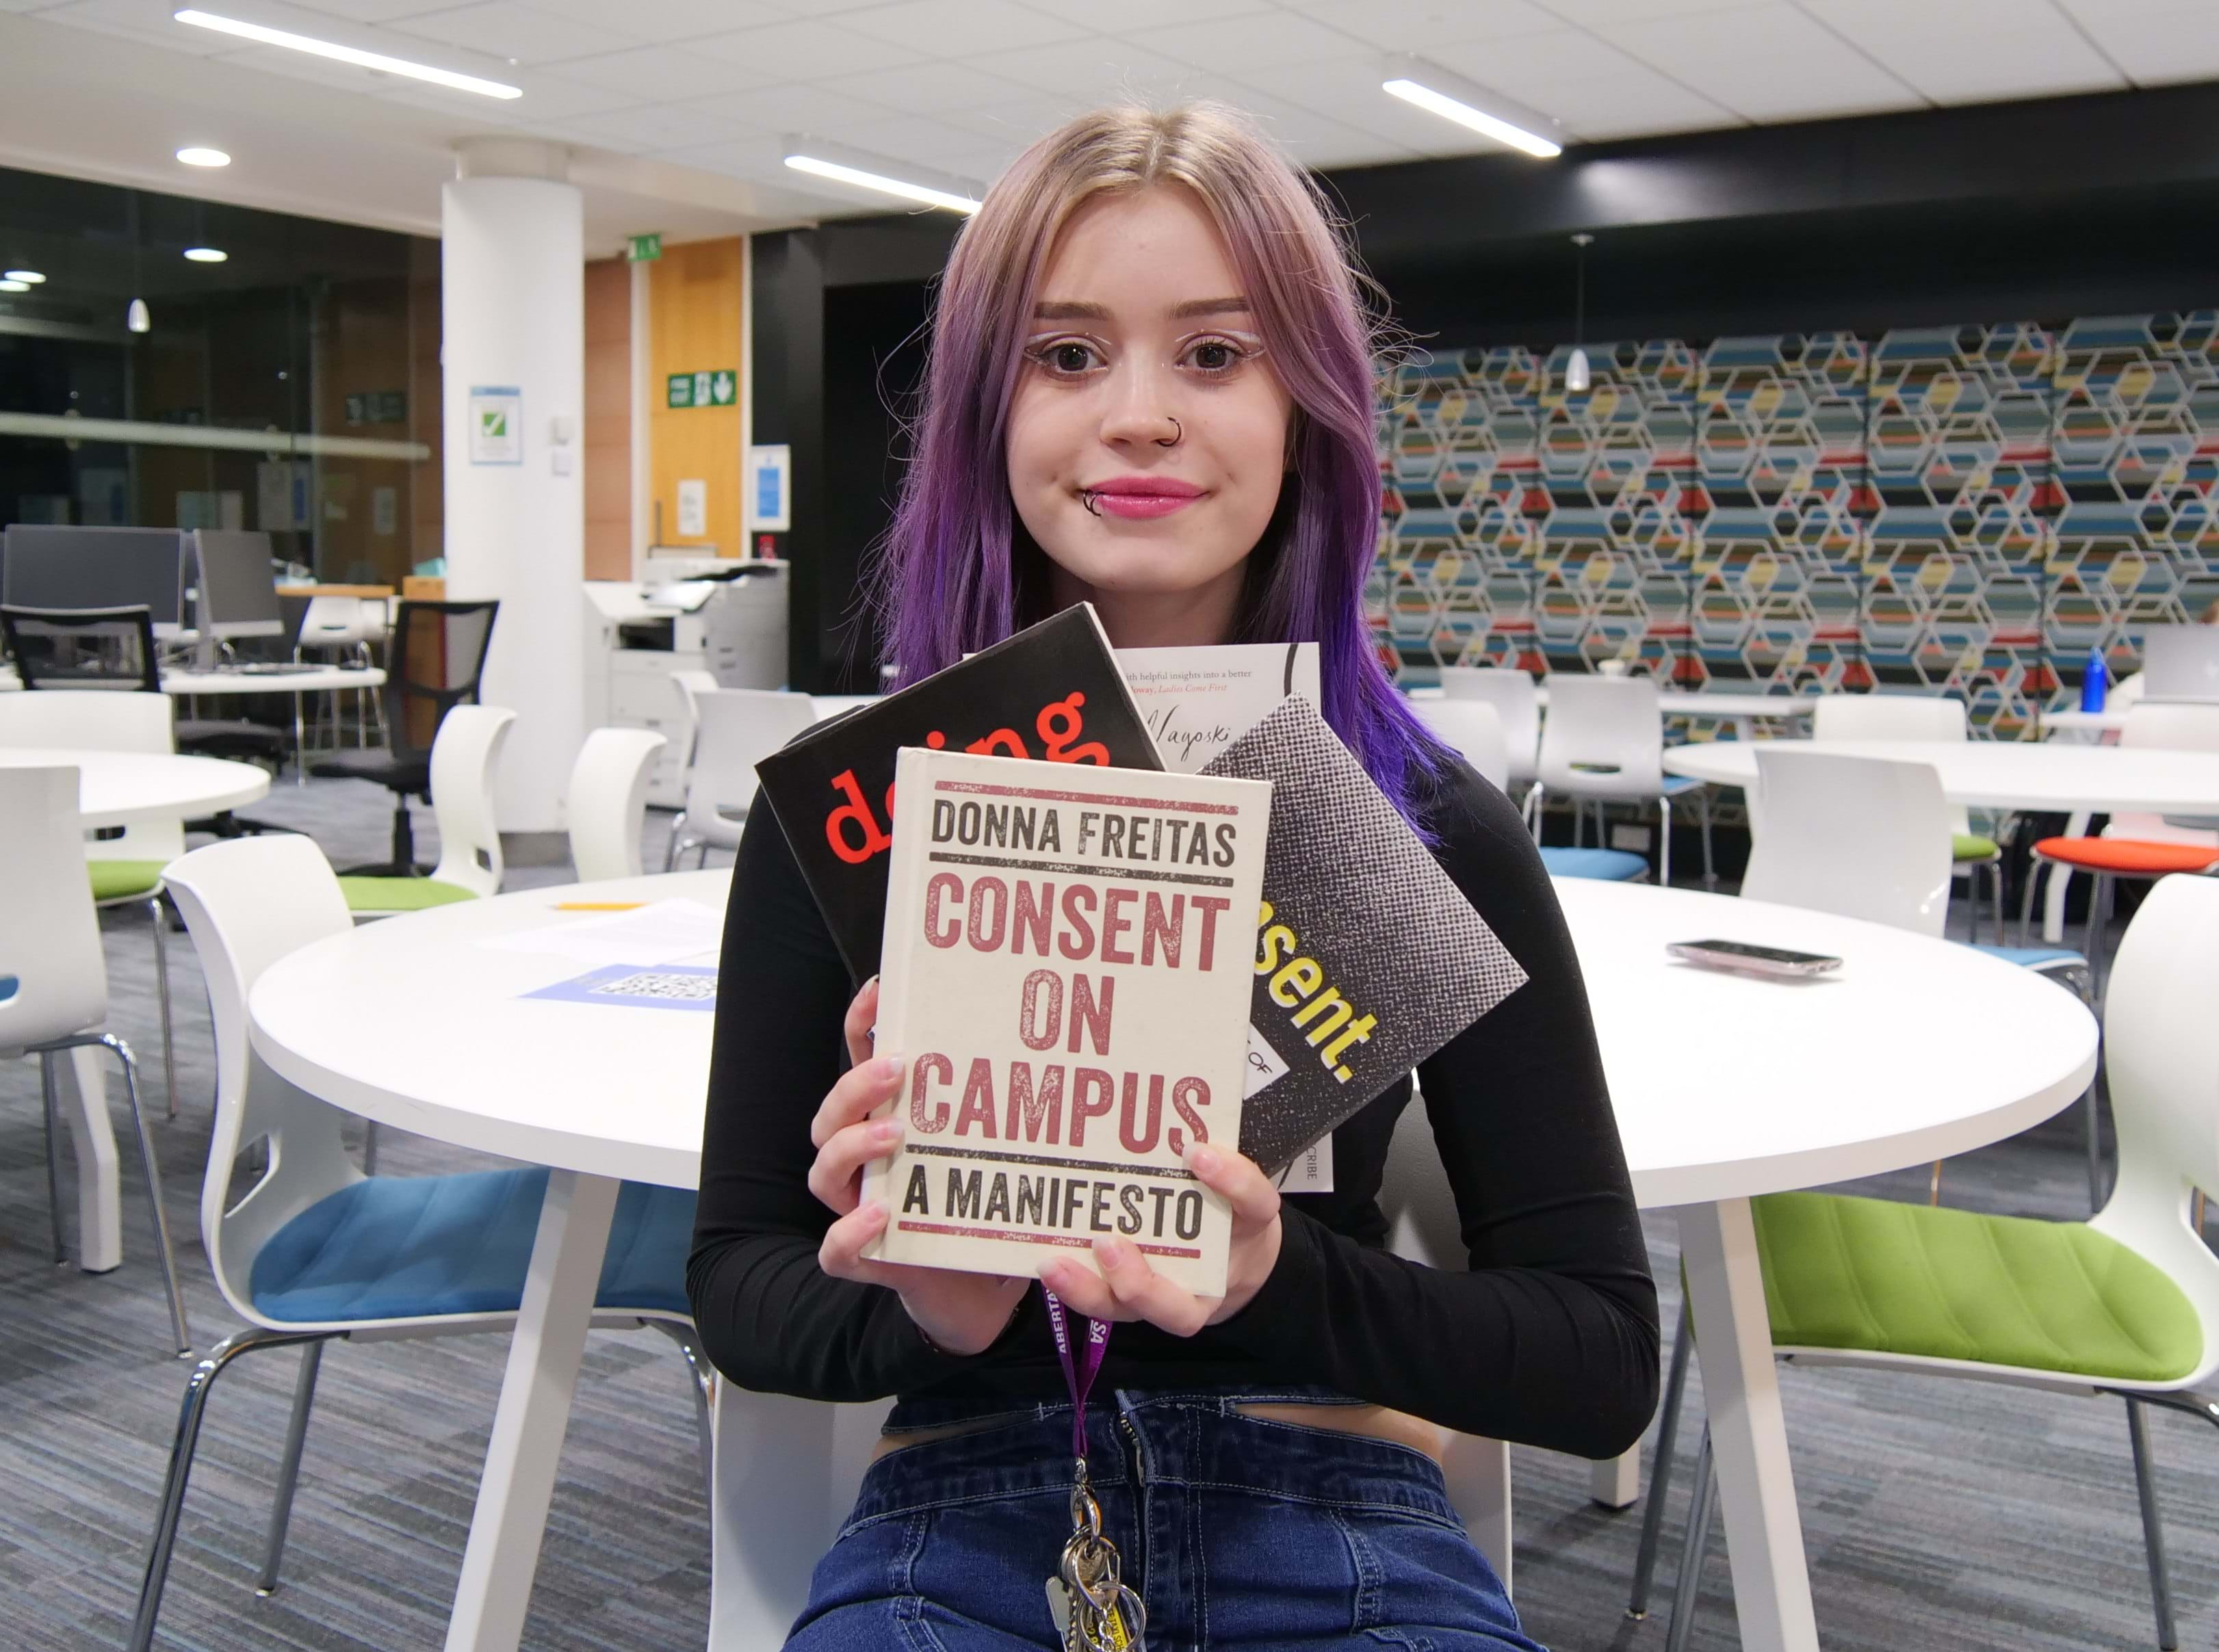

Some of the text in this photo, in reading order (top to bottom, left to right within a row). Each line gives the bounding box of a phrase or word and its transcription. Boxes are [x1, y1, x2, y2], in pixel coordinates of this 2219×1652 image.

[1126, 672, 1138, 681] ith
[1140, 672, 1168, 683] helpful
[1170, 670, 1201, 683] insights
[1203, 671, 1219, 679] into
[1228, 670, 1253, 679] better
[1131, 685, 1156, 696] loway,
[1158, 685, 1184, 694] Ladies
[1208, 684, 1228, 692] First
[932, 799, 1236, 867] DONNA FREITAS
[924, 872, 1230, 971] CONSENT
[1020, 969, 1115, 1056] ON
[1257, 900, 1378, 1084] sent.
[1248, 1051, 1273, 1074] OF
[910, 1052, 1211, 1157] CAMPUS
[1307, 1146, 1317, 1181] CRIBE
[903, 1164, 1204, 1240] A MANIFESTO
[1046, 1289, 1067, 1354] ABERTA
